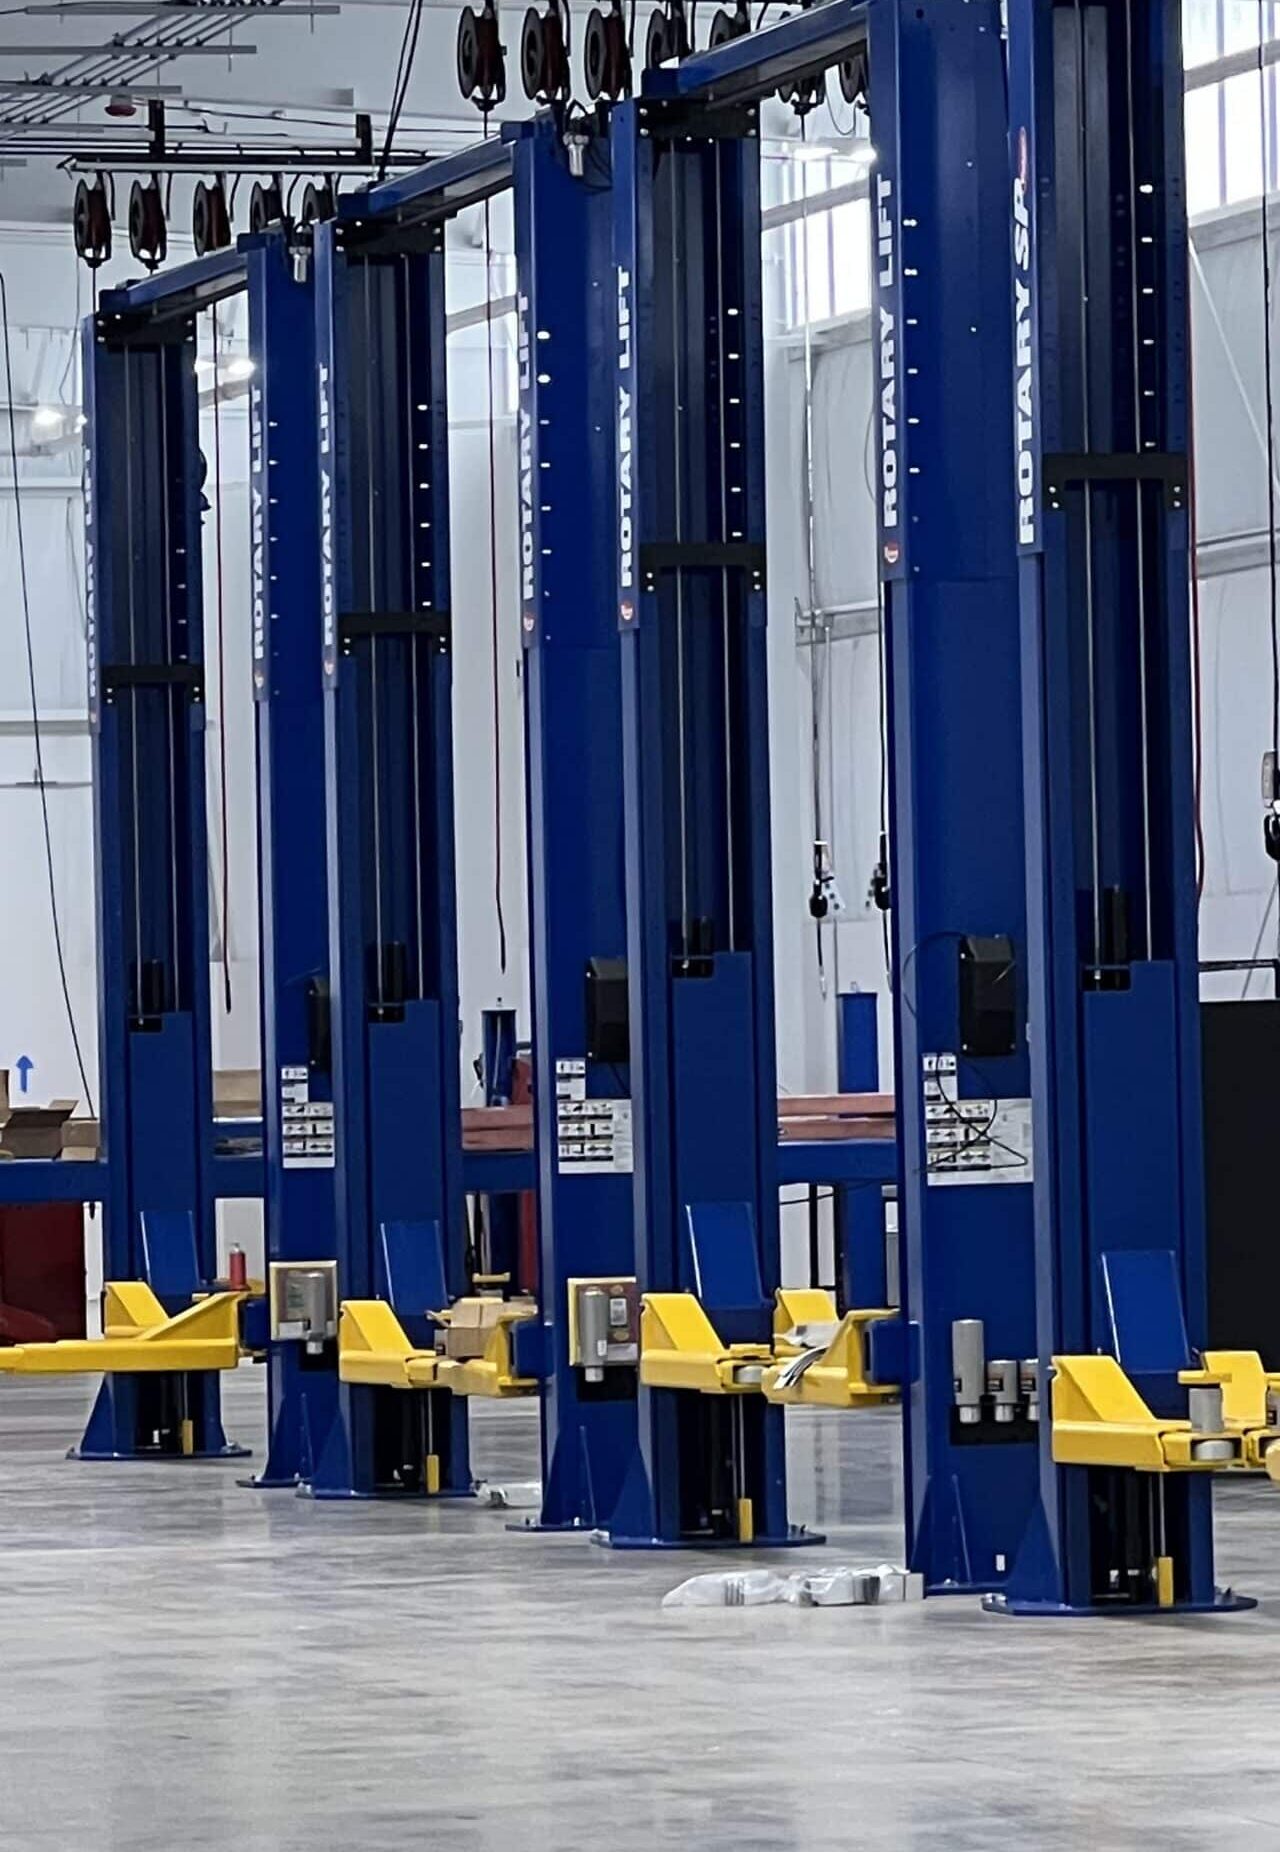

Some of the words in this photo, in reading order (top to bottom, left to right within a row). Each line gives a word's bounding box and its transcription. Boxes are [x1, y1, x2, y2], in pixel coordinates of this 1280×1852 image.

[617, 265, 630, 369] LIFT
[876, 173, 893, 288] LIFT
[318, 363, 330, 454] LIFT
[517, 291, 530, 390] LIFT
[879, 305, 897, 528] ROTARY
[1015, 278, 1034, 545] ROTARY
[251, 384, 262, 473] LIFT
[518, 408, 534, 601] ROTARY
[619, 386, 632, 588] ROTARY
[252, 486, 264, 660] ROTARY
[321, 470, 333, 646] ROTARY
